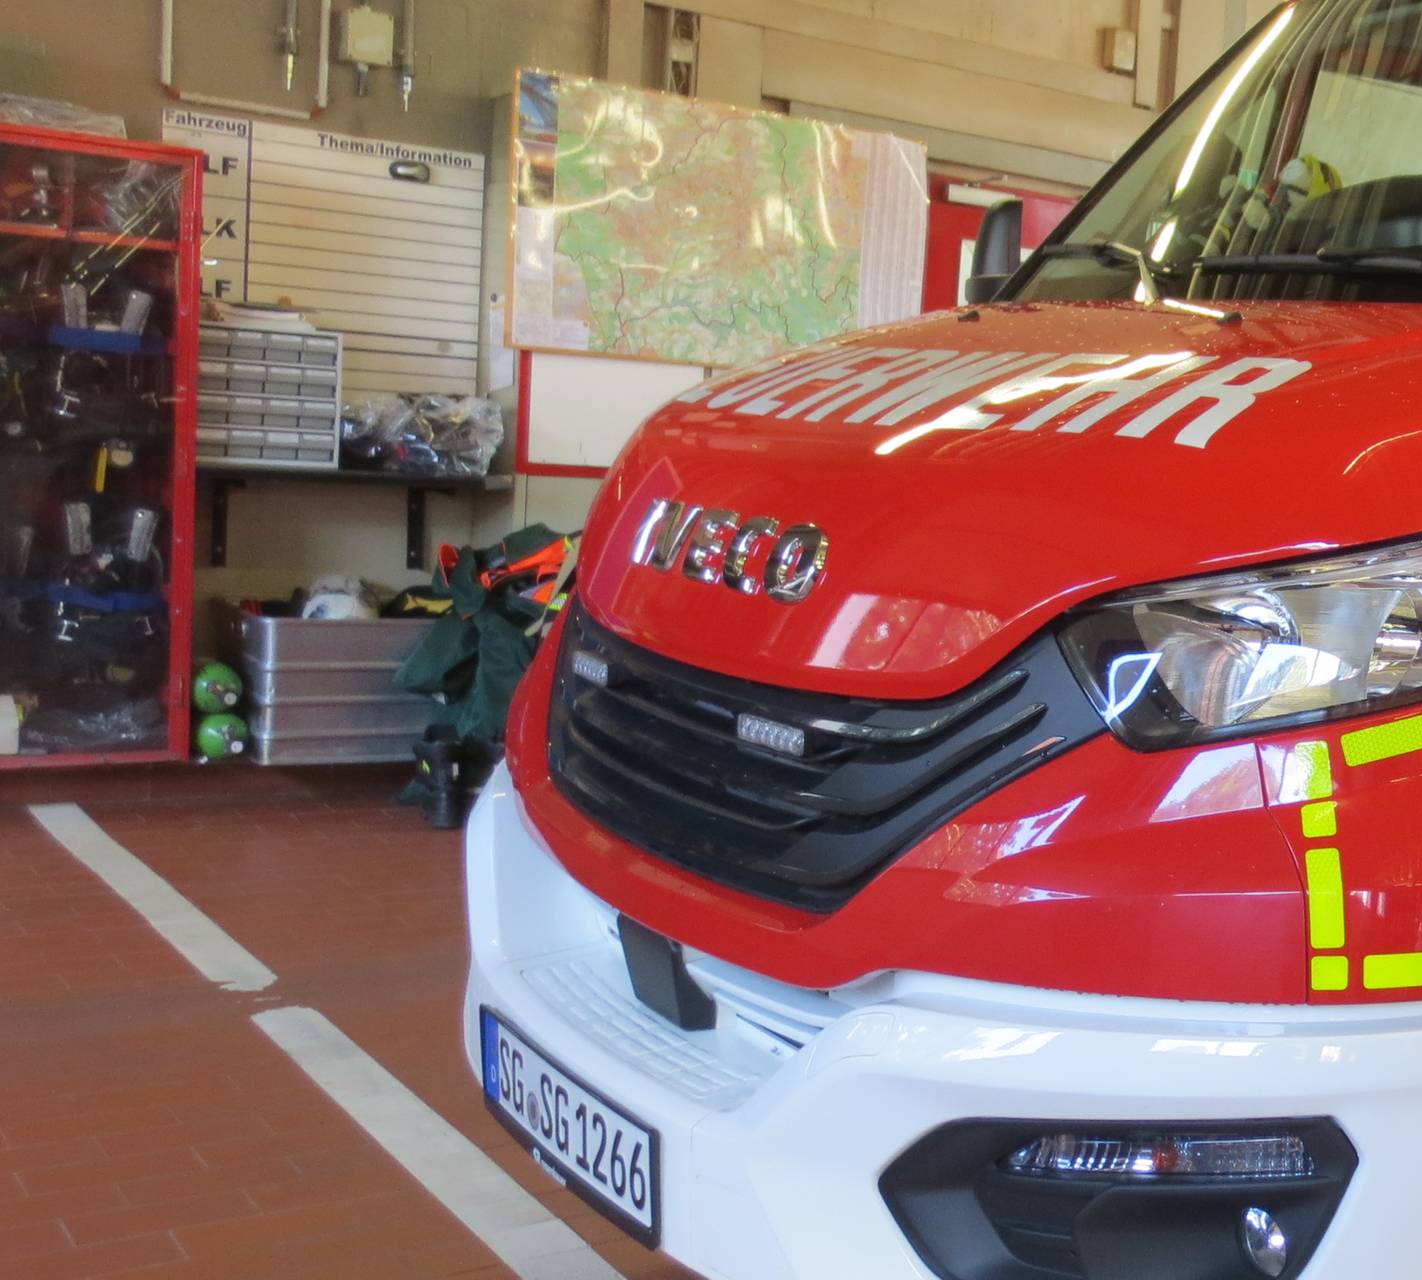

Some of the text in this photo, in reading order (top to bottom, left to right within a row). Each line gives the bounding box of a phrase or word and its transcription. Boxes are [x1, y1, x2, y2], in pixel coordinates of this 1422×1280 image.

[165, 109, 247, 137] Fahrzeug
[318, 133, 472, 168] Thema/Information
[630, 498, 830, 605] IVECO
[500, 1037, 524, 1116] SG
[540, 1072, 569, 1156] SG
[575, 1102, 646, 1211] 1266
